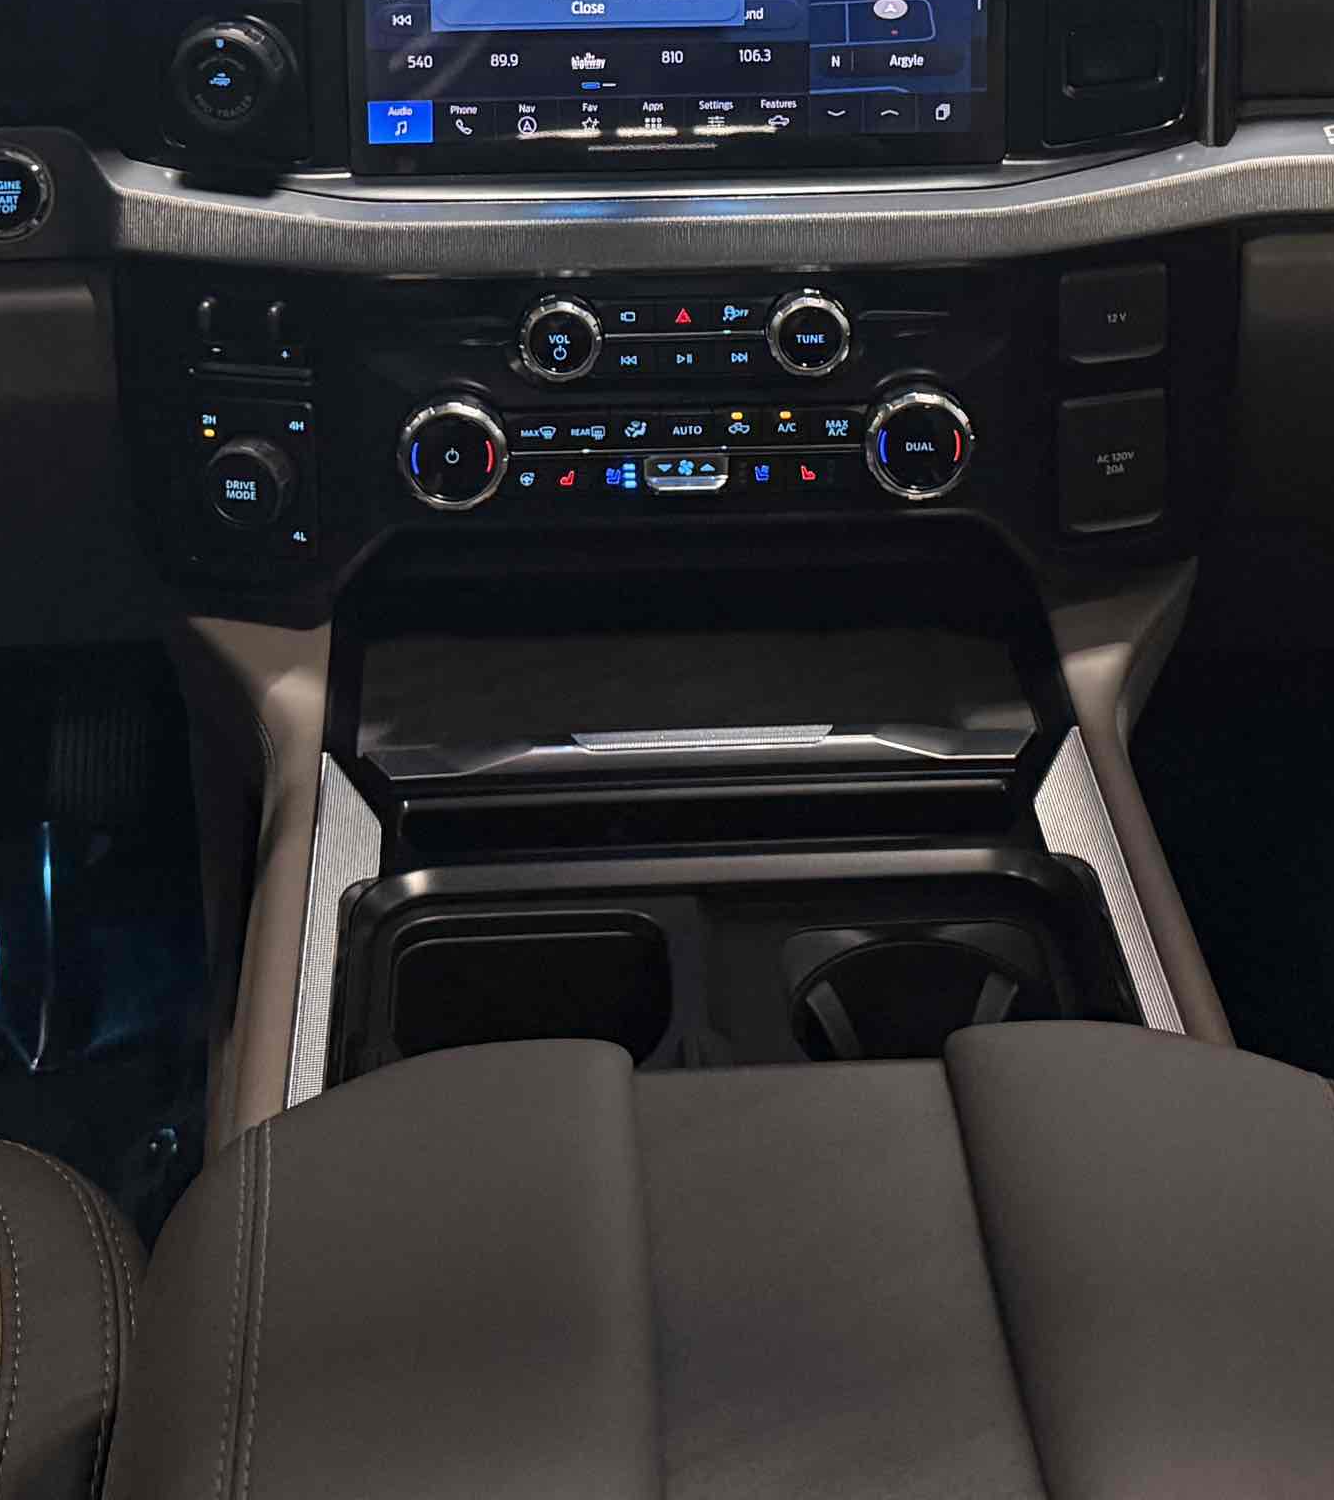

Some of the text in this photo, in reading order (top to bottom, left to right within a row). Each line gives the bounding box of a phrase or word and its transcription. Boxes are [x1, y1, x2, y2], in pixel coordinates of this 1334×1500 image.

[571, 1, 605, 15] Close
[490, 53, 518, 68] 89.9
[661, 50, 684, 64] 810
[738, 48, 772, 63] 106.3
[889, 54, 924, 68] Argyle
[407, 55, 433, 69] 540
[831, 55, 841, 68] N
[450, 105, 478, 115] Phone
[519, 104, 535, 114] Nav
[582, 103, 598, 113] Fav
[642, 101, 665, 113] Apps
[698, 100, 734, 111] Settings
[760, 100, 797, 109] Features
[387, 105, 413, 117] Audio
[1106, 311, 1127, 324] 12 V
[548, 334, 571, 345] VOL
[795, 334, 826, 344] TUNE
[202, 414, 217, 425] 2H
[825, 419, 849, 429] MAX
[288, 421, 305, 431] 4H
[571, 427, 591, 436] REAR
[672, 425, 703, 436] AUTO
[778, 422, 796, 433] A/C
[520, 427, 540, 437] MAX
[827, 427, 848, 437] A/C
[905, 441, 935, 451] DUAL
[226, 480, 256, 491] DRIVE
[226, 490, 257, 501] MODE
[292, 531, 308, 542] 4L
